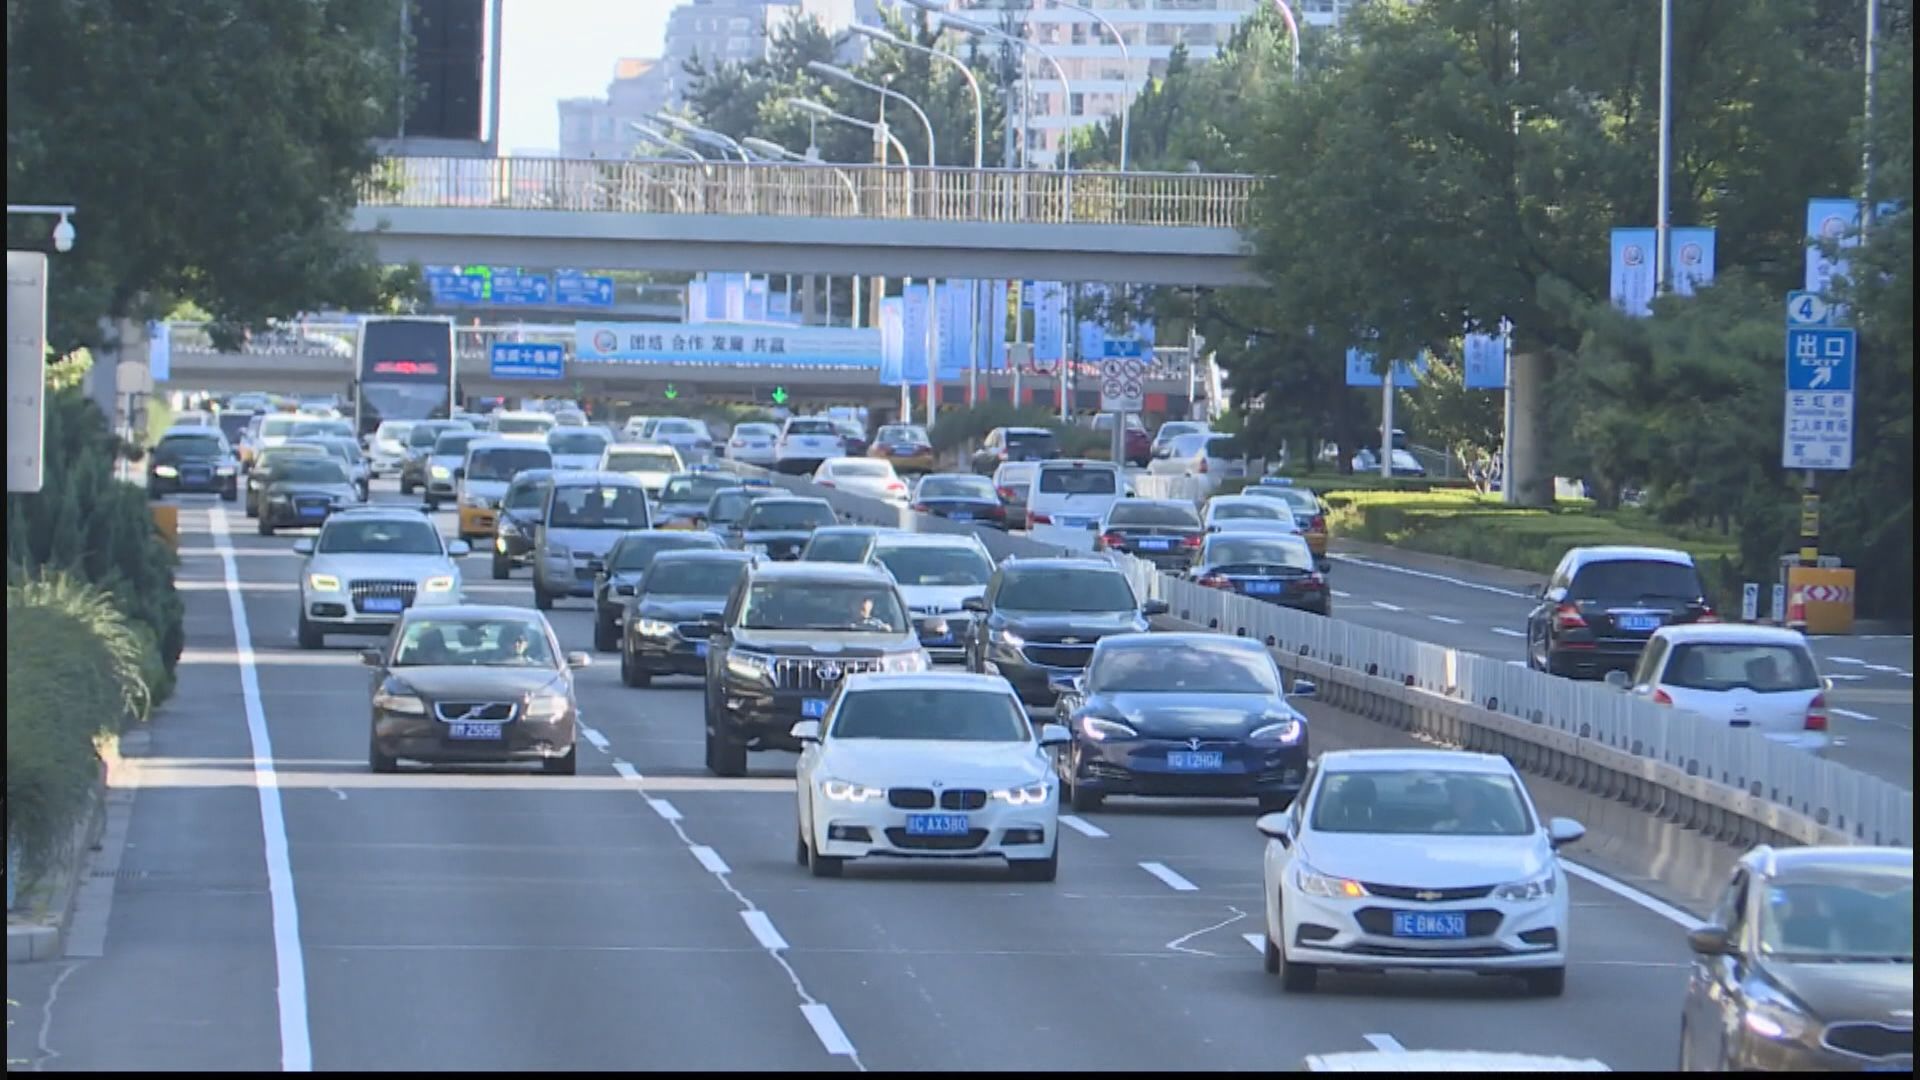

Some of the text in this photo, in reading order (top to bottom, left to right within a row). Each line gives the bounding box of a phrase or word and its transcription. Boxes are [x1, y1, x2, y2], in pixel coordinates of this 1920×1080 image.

[1799, 298, 1812, 319] 4
[630, 333, 785, 354] 团结 合作 发展 共赢
[1796, 333, 1844, 357] 出口
[1801, 358, 1840, 367] EXIT
[1791, 418, 1848, 432] 工人体育场
